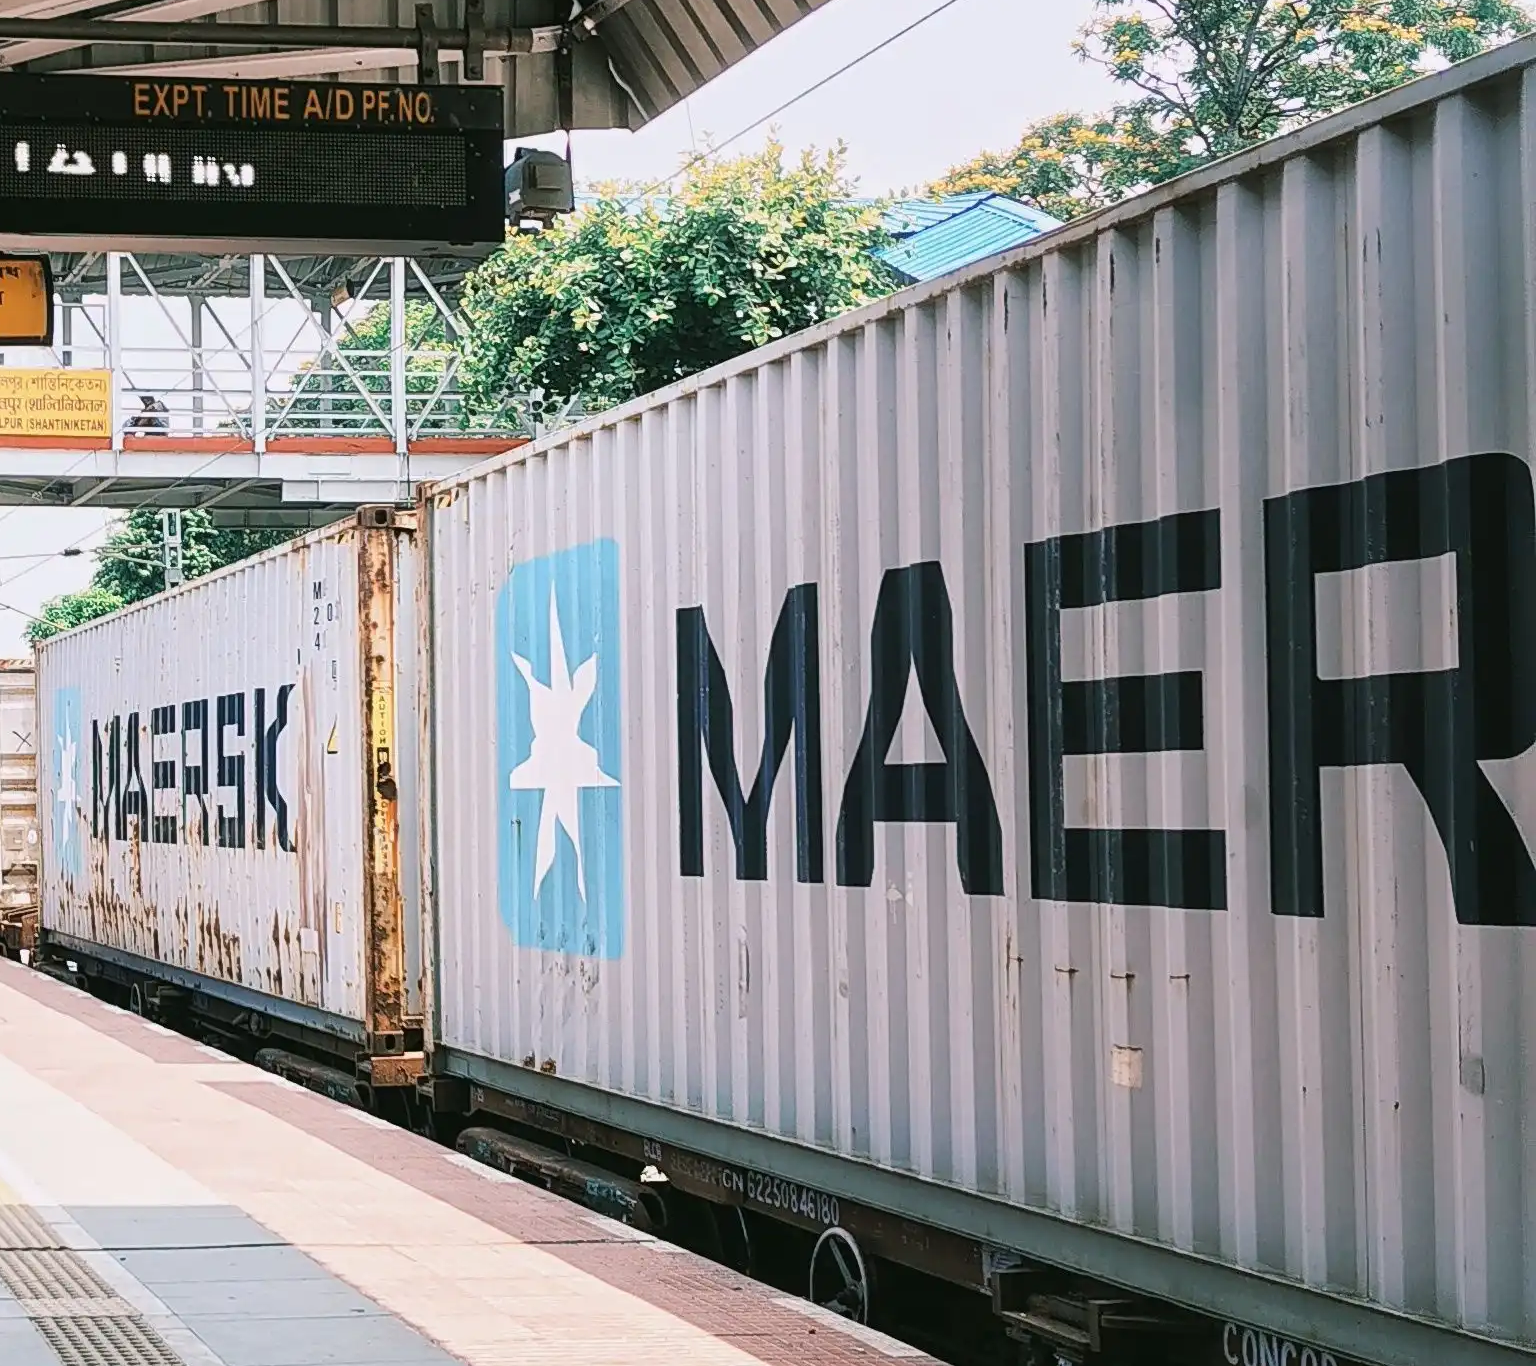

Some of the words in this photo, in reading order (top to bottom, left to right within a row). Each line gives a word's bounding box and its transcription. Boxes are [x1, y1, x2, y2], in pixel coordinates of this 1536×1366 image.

[224, 86, 290, 120] TIME
[304, 88, 354, 121] A/D
[26, 418, 108, 434] (SHANTINIKETAN)
[676, 452, 1536, 926] MAER
[93, 684, 297, 853] MAERSK
